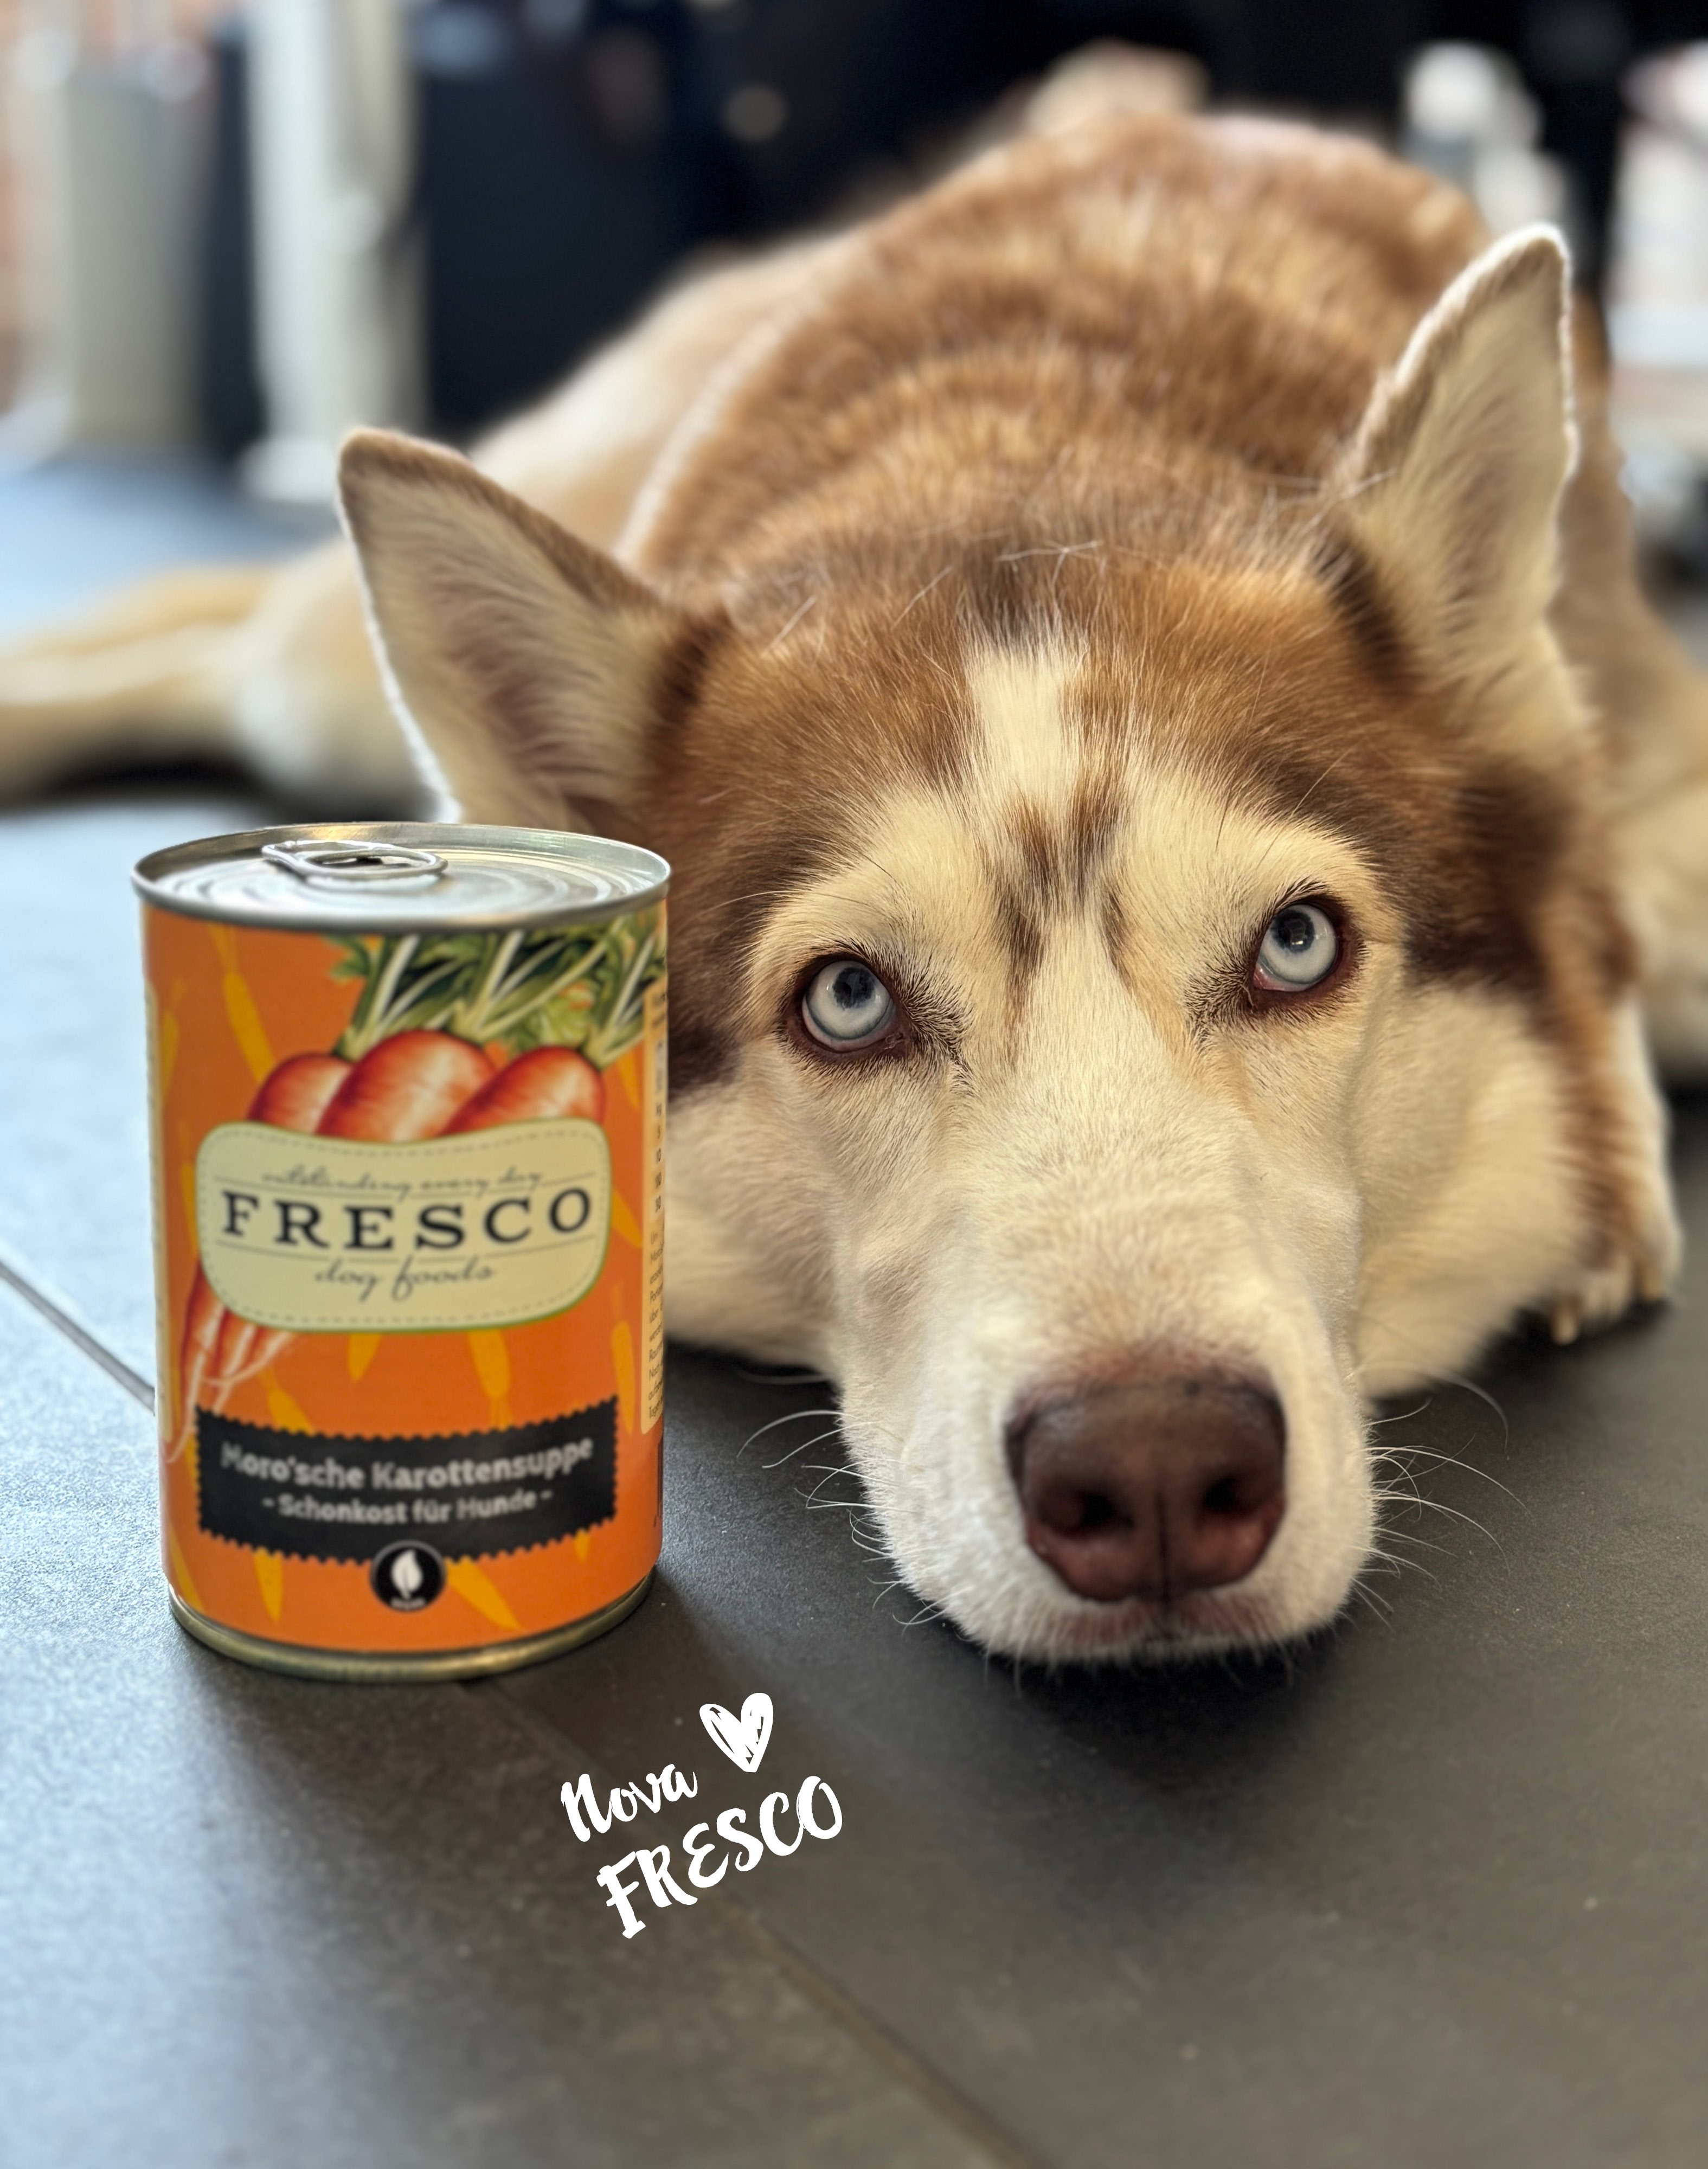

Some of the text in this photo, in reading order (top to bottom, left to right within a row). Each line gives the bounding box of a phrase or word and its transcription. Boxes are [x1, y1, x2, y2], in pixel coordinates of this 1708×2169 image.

[221, 1187, 592, 1252] FRESCO
[316, 1255, 495, 1302] dog foods
[371, 1437, 593, 1490] Karottensuppe
[277, 1492, 407, 1524] Schonkost
[412, 1494, 452, 1524] für
[457, 1488, 537, 1520] Hunde
